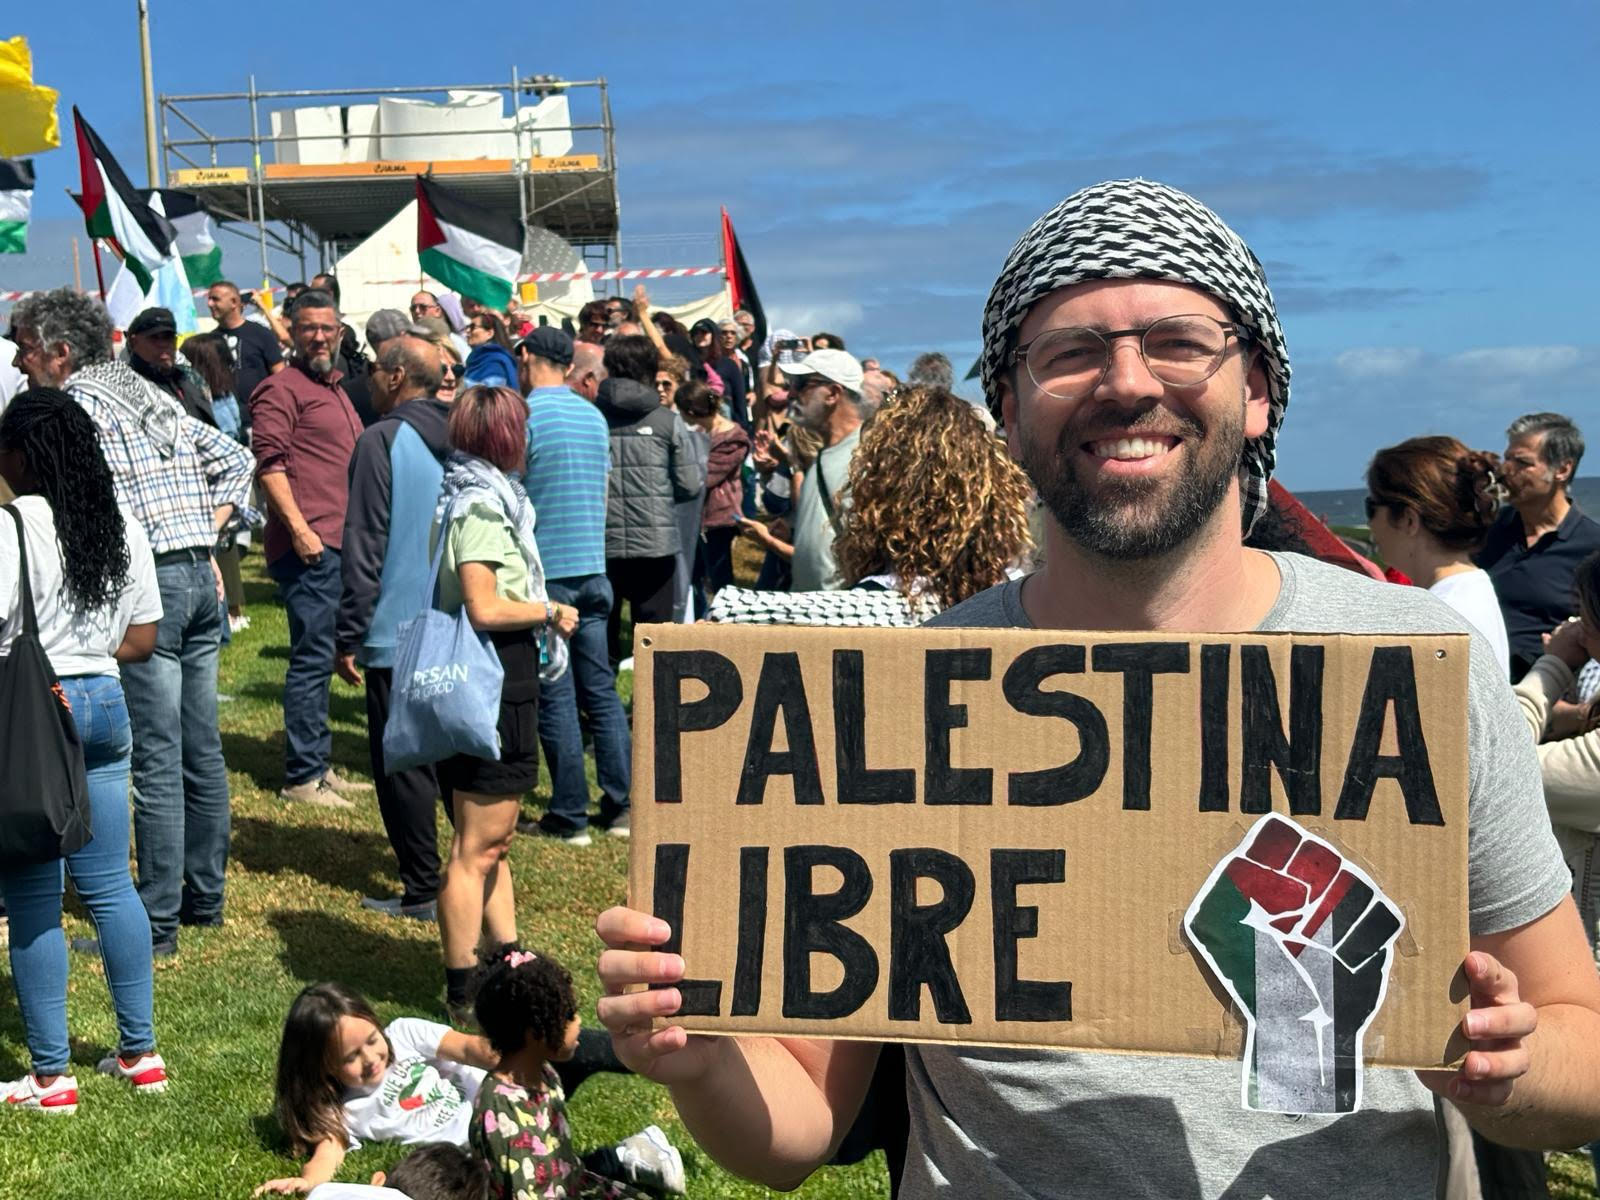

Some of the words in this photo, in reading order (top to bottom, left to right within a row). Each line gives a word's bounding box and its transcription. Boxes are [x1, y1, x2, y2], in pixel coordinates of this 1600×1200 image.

[423, 681, 455, 697] GOOD
[653, 642, 1446, 826] PALESTINA
[649, 844, 1073, 1025] LIBRE
[382, 1079, 403, 1107] SAVE
